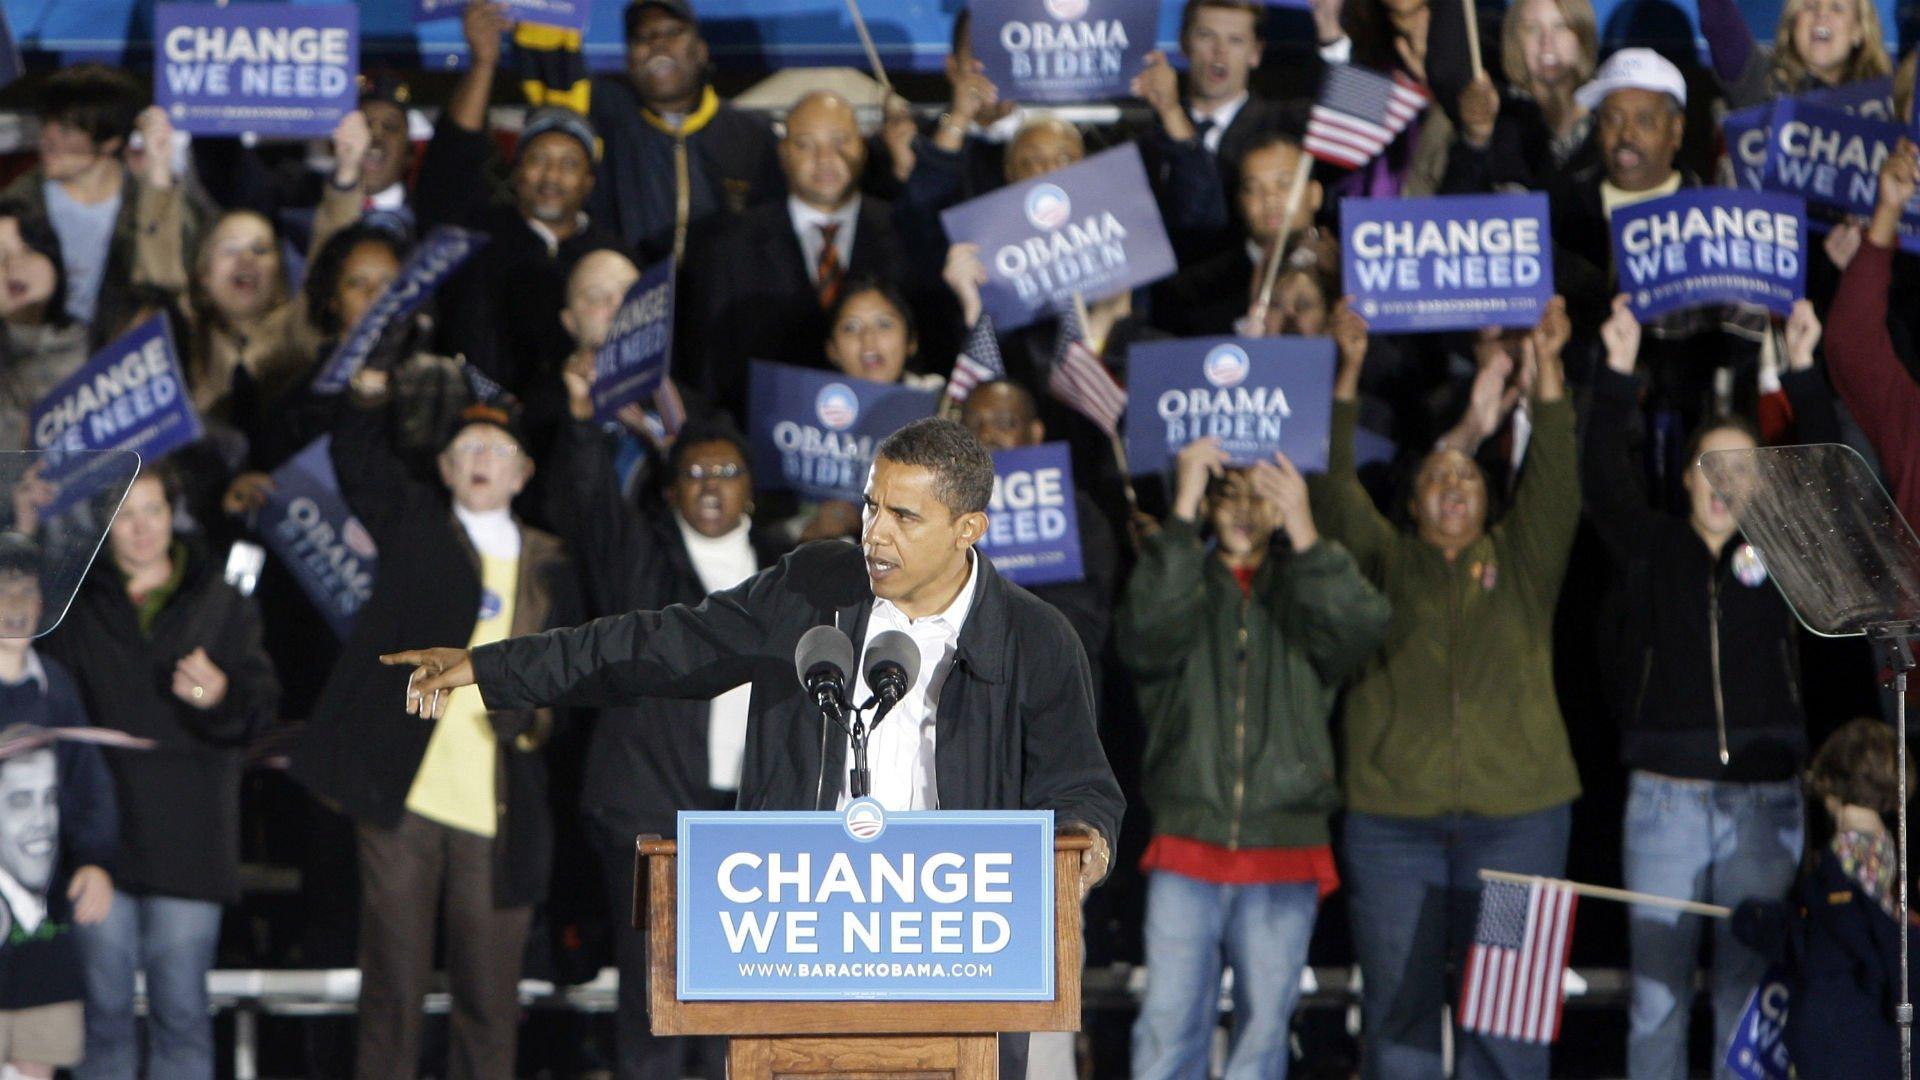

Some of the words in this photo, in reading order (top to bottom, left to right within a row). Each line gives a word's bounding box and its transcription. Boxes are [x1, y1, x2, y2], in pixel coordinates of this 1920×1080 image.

[165, 26, 349, 64] CHANGE
[1001, 19, 1128, 53] OBAMA
[166, 63, 230, 95] WE
[242, 64, 347, 97] NEED
[1011, 49, 1122, 79] BIDEN
[996, 211, 1127, 278] OBAMA
[1352, 217, 1541, 260] CHANGE
[1622, 205, 1799, 256] CHANGE
[1354, 256, 1420, 291] WE
[1433, 254, 1541, 289] NEED
[1626, 243, 1687, 285] WE
[1701, 238, 1799, 280] NEED
[35, 336, 170, 448] CHANGE
[89, 374, 177, 444] NEED
[1157, 386, 1291, 420] OBAMA
[1165, 413, 1282, 444] BIDEN
[717, 852, 1014, 904] CHANGE
[718, 911, 818, 954] WE
[843, 911, 1012, 954] NEED
[738, 963, 993, 978] WWW.BARACKOBAMA.COM
